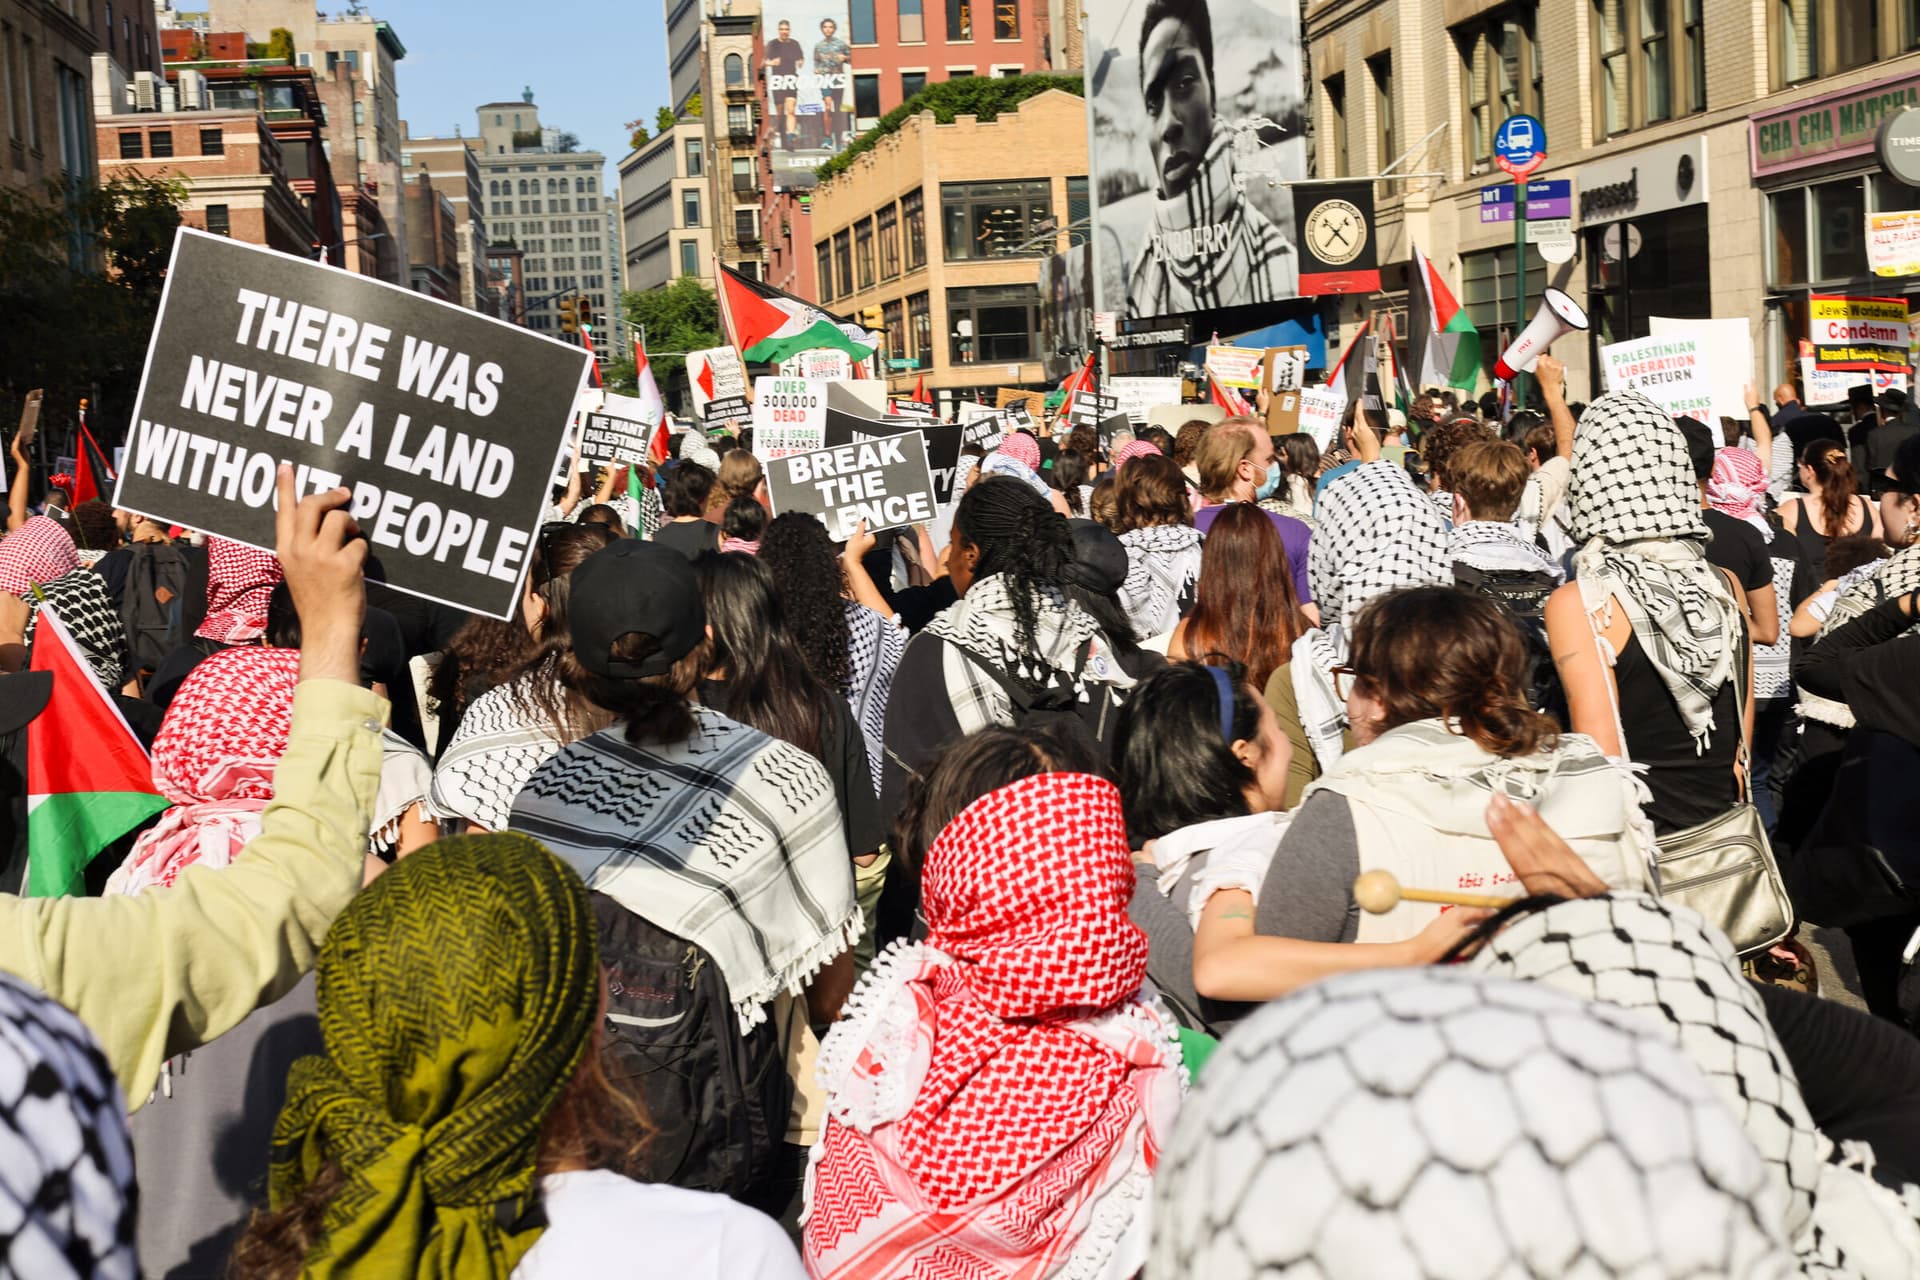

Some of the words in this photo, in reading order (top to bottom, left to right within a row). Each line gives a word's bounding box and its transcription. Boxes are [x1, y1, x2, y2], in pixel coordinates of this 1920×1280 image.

[769, 73, 846, 90] BROOKS
[1759, 119, 1793, 154] CHA
[1798, 109, 1834, 146] CHA
[1838, 87, 1918, 137] MATCHA
[1483, 188, 1500, 202] M1
[1482, 206, 1499, 221] M1
[1152, 222, 1236, 263] BURBERRY
[1818, 304, 1848, 316] Jews
[1850, 305, 1904, 319] Worldwide
[1828, 322, 1898, 341] Condemn
[236, 288, 392, 382] THERE
[397, 335, 504, 417] WAS
[1612, 341, 1696, 366] PALESTINIAN
[1618, 355, 1696, 378] LIBERATION
[774, 381, 806, 394] OVER
[1628, 379, 1636, 390] &
[1641, 369, 1693, 387] RETURN
[763, 395, 817, 409] 300,000
[1302, 396, 1337, 411] SISTING
[1670, 396, 1712, 411] MEANS
[774, 409, 806, 423] DEAD
[180, 355, 333, 446] NEVER
[335, 402, 375, 460] A
[384, 415, 514, 499] LAND
[591, 416, 609, 429] WE
[611, 419, 646, 437] WANT
[788, 429, 820, 438] ISRAEL
[582, 442, 597, 455] TO
[598, 444, 614, 457] BE
[585, 428, 647, 452] PALESTINE
[760, 439, 785, 448] YOUR
[788, 439, 819, 448] HANDS
[787, 438, 907, 484] BREAK
[814, 470, 887, 507] THE
[816, 491, 932, 540] LENCE
[348, 481, 530, 584] PEOPLE
